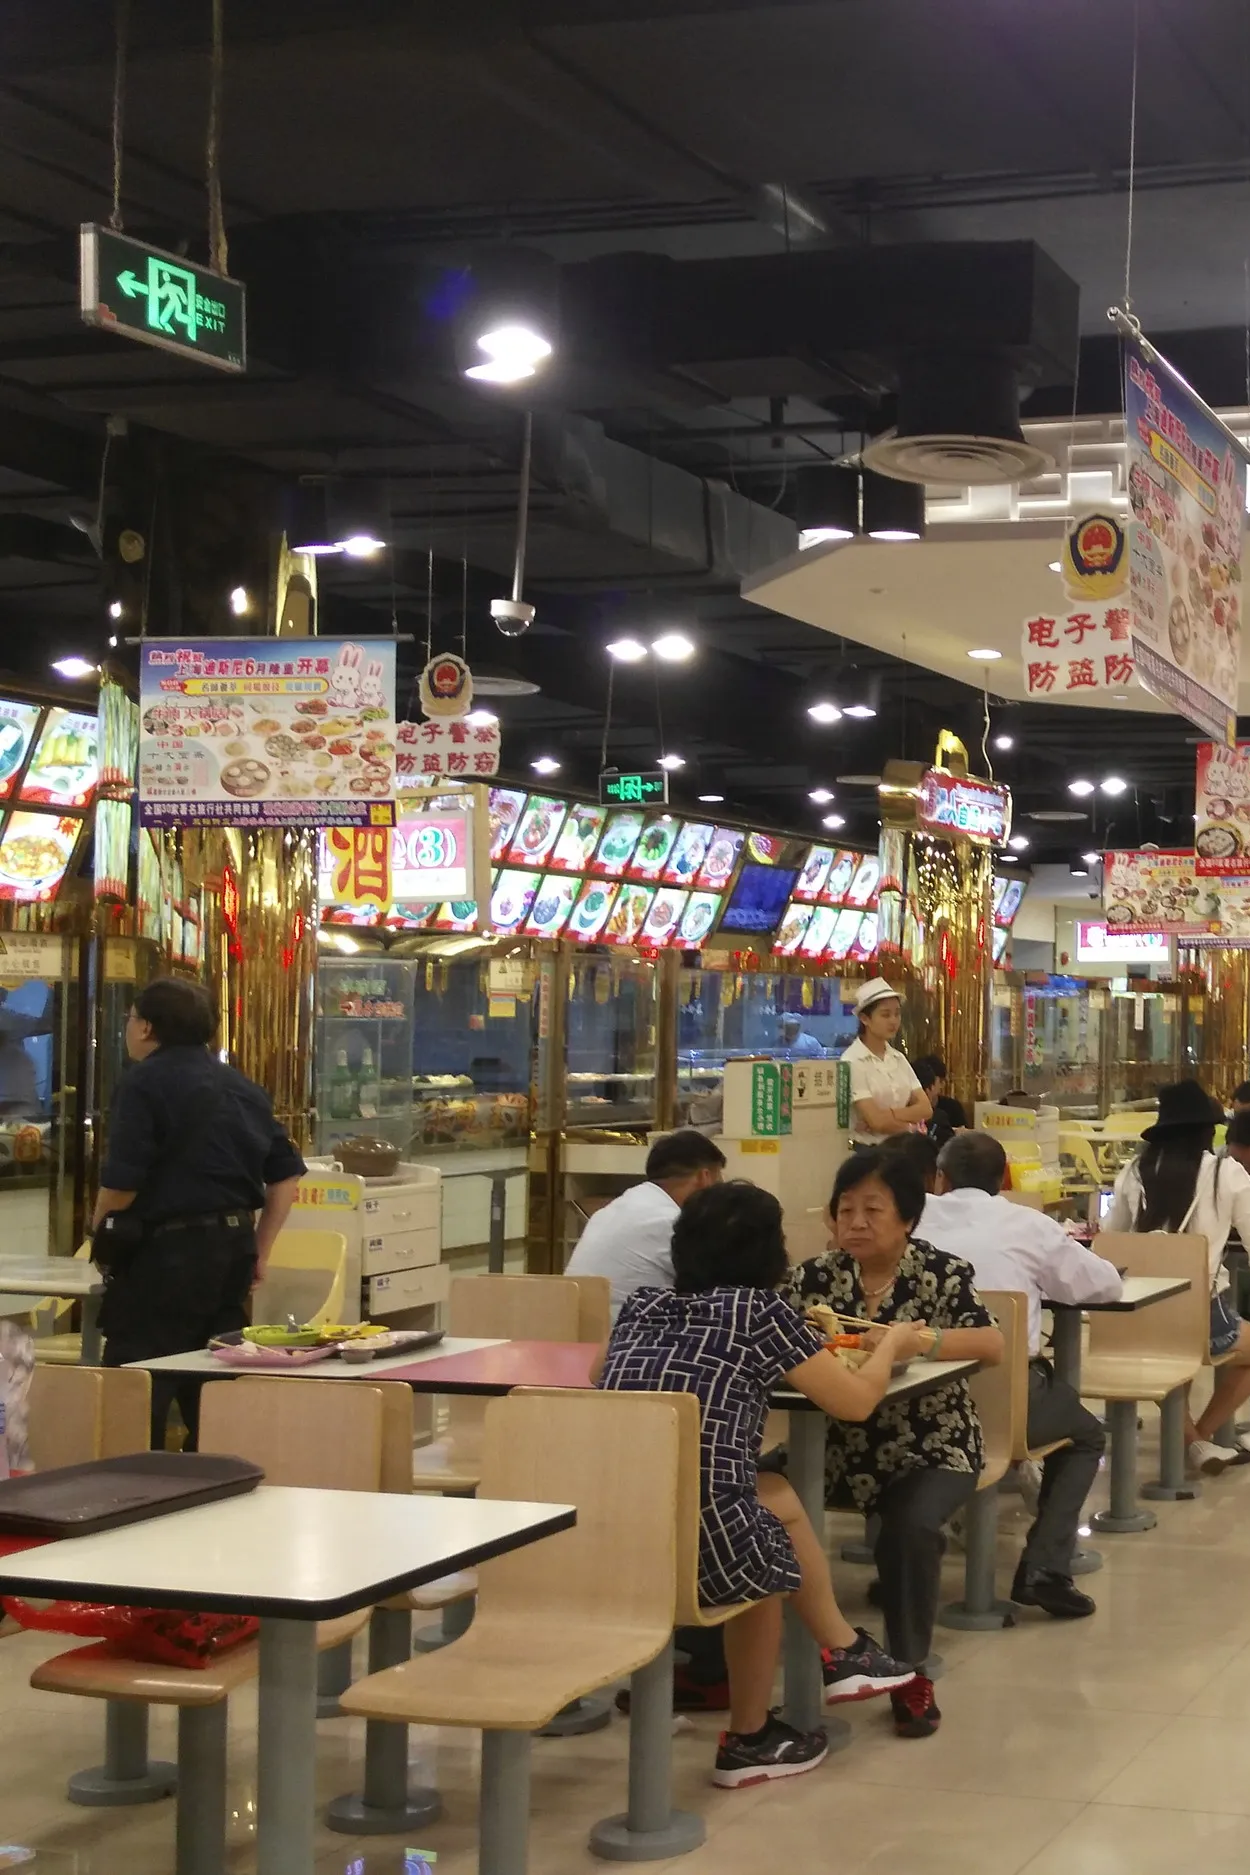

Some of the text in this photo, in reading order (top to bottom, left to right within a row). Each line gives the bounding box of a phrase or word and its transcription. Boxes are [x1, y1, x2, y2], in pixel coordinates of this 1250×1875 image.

[195, 313, 226, 334] EXIT
[397, 722, 498, 745] 电子警察
